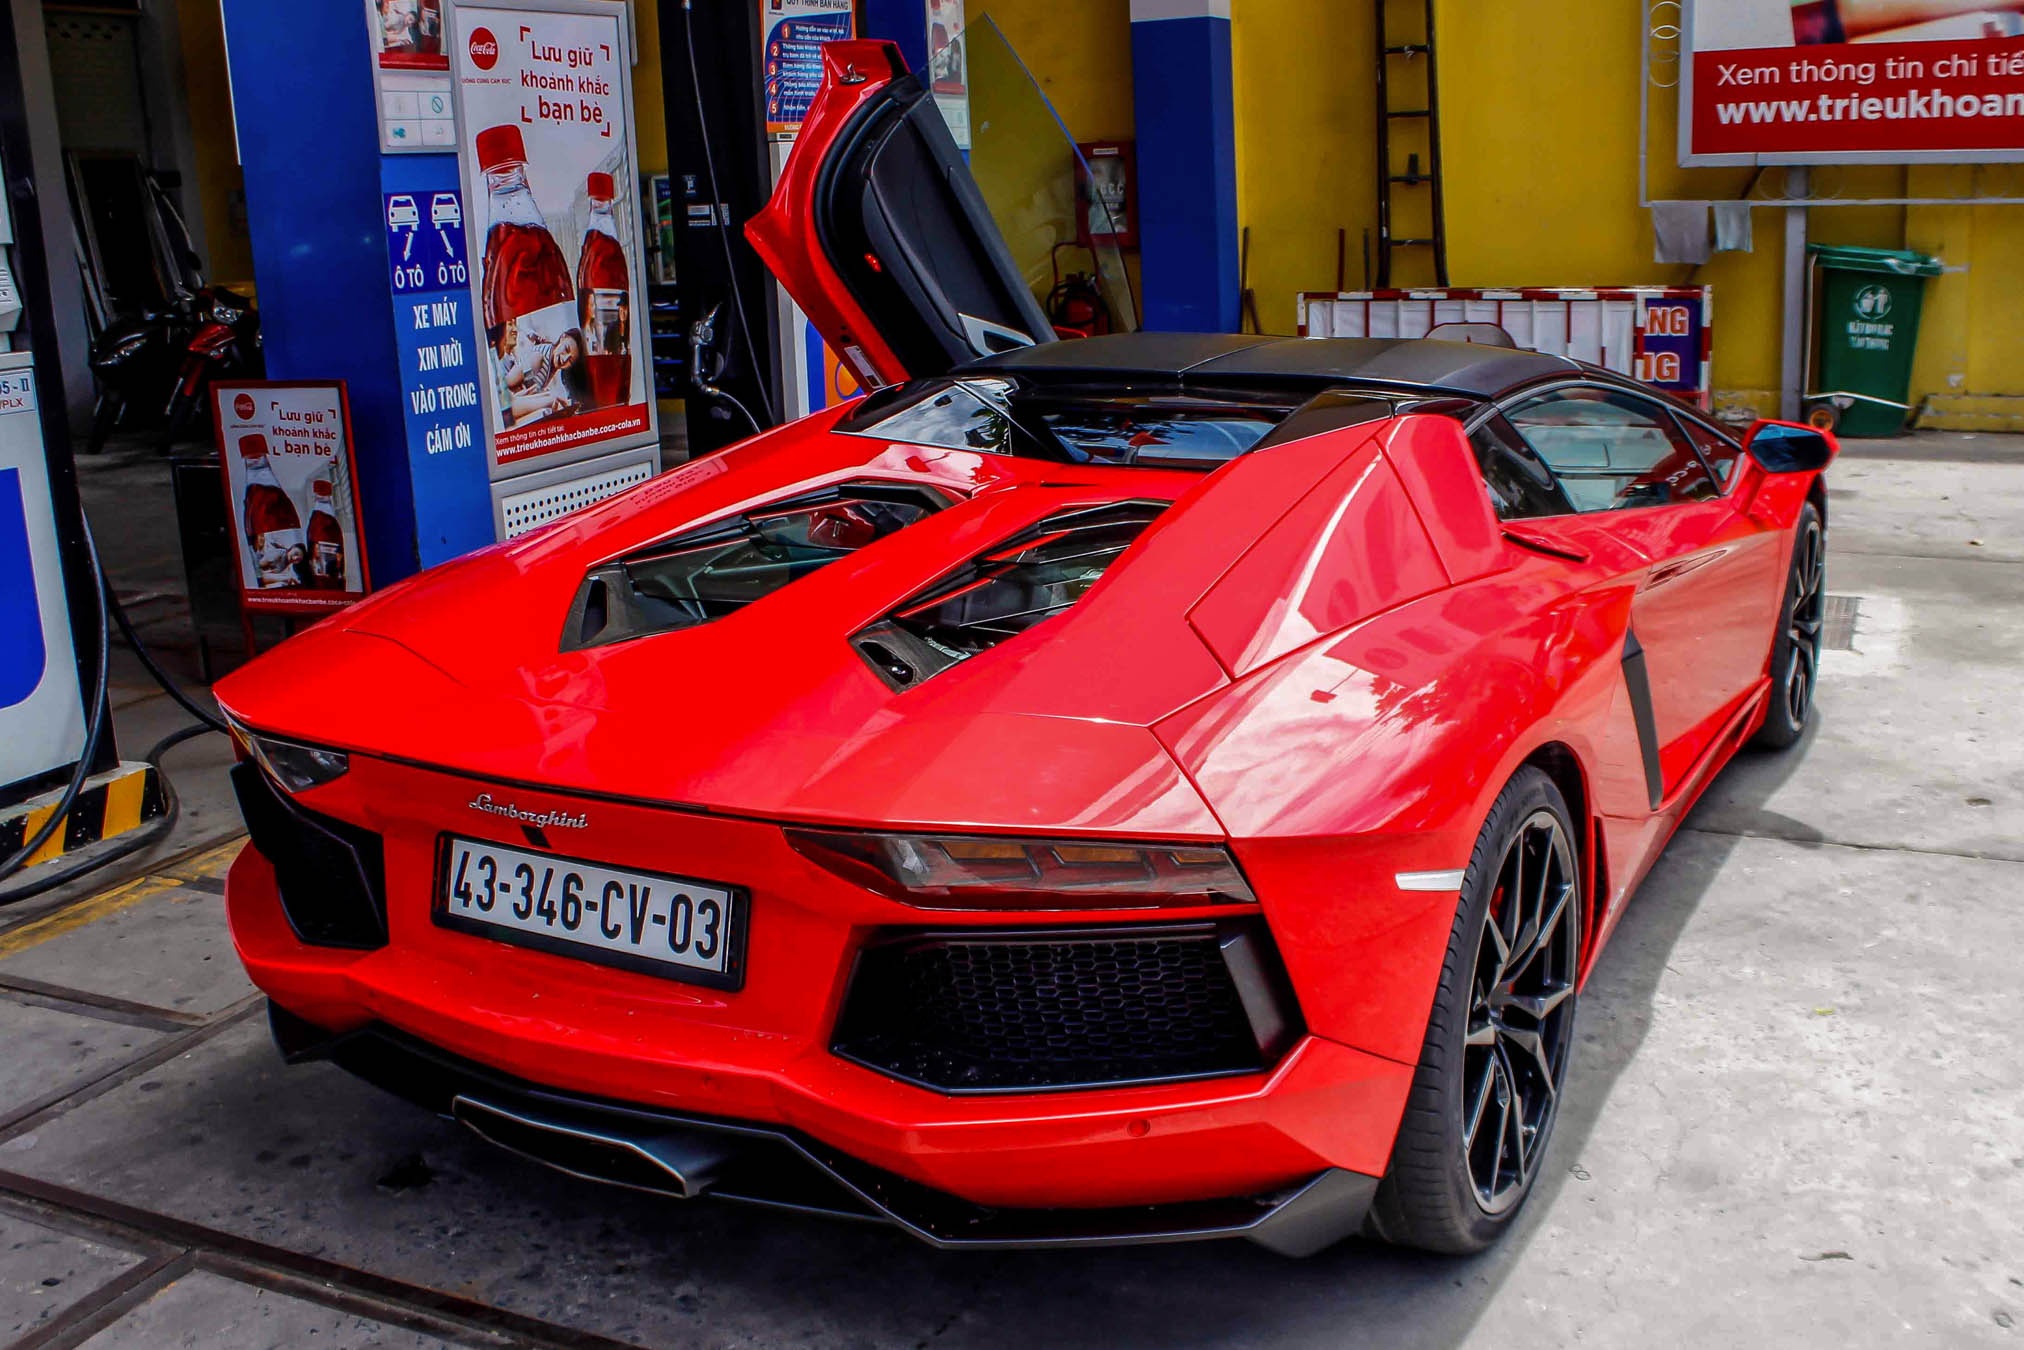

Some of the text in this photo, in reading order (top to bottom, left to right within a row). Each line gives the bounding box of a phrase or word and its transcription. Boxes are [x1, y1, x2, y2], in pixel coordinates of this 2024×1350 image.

[531, 41, 594, 68] Lưu giữ
[773, 46, 778, 57] 2
[521, 69, 610, 97] khoảnh khắc
[770, 64, 776, 76] 3
[1716, 64, 1780, 87] Xem
[1789, 58, 1876, 86] thông
[1885, 56, 1924, 80] tin
[1932, 53, 1978, 79] chi
[771, 84, 776, 95] 4
[538, 95, 603, 125] bạn bè
[771, 103, 777, 114] 5
[395, 263, 424, 289] Ô TÔ
[438, 260, 466, 285] Ô TÔ
[413, 296, 458, 330] XE MÁY
[1644, 306, 1689, 336] NG
[417, 337, 463, 372] XIN MỜI
[411, 382, 477, 415] VÀO TRONG
[279, 409, 324, 424] Lưu giữ
[272, 425, 310, 439] khoảnh
[426, 421, 471, 455] CÁM ƠN
[284, 440, 332, 458] bạn bè
[468, 793, 590, 830] Lamborghini
[453, 850, 722, 960] 43-346-CV-03
